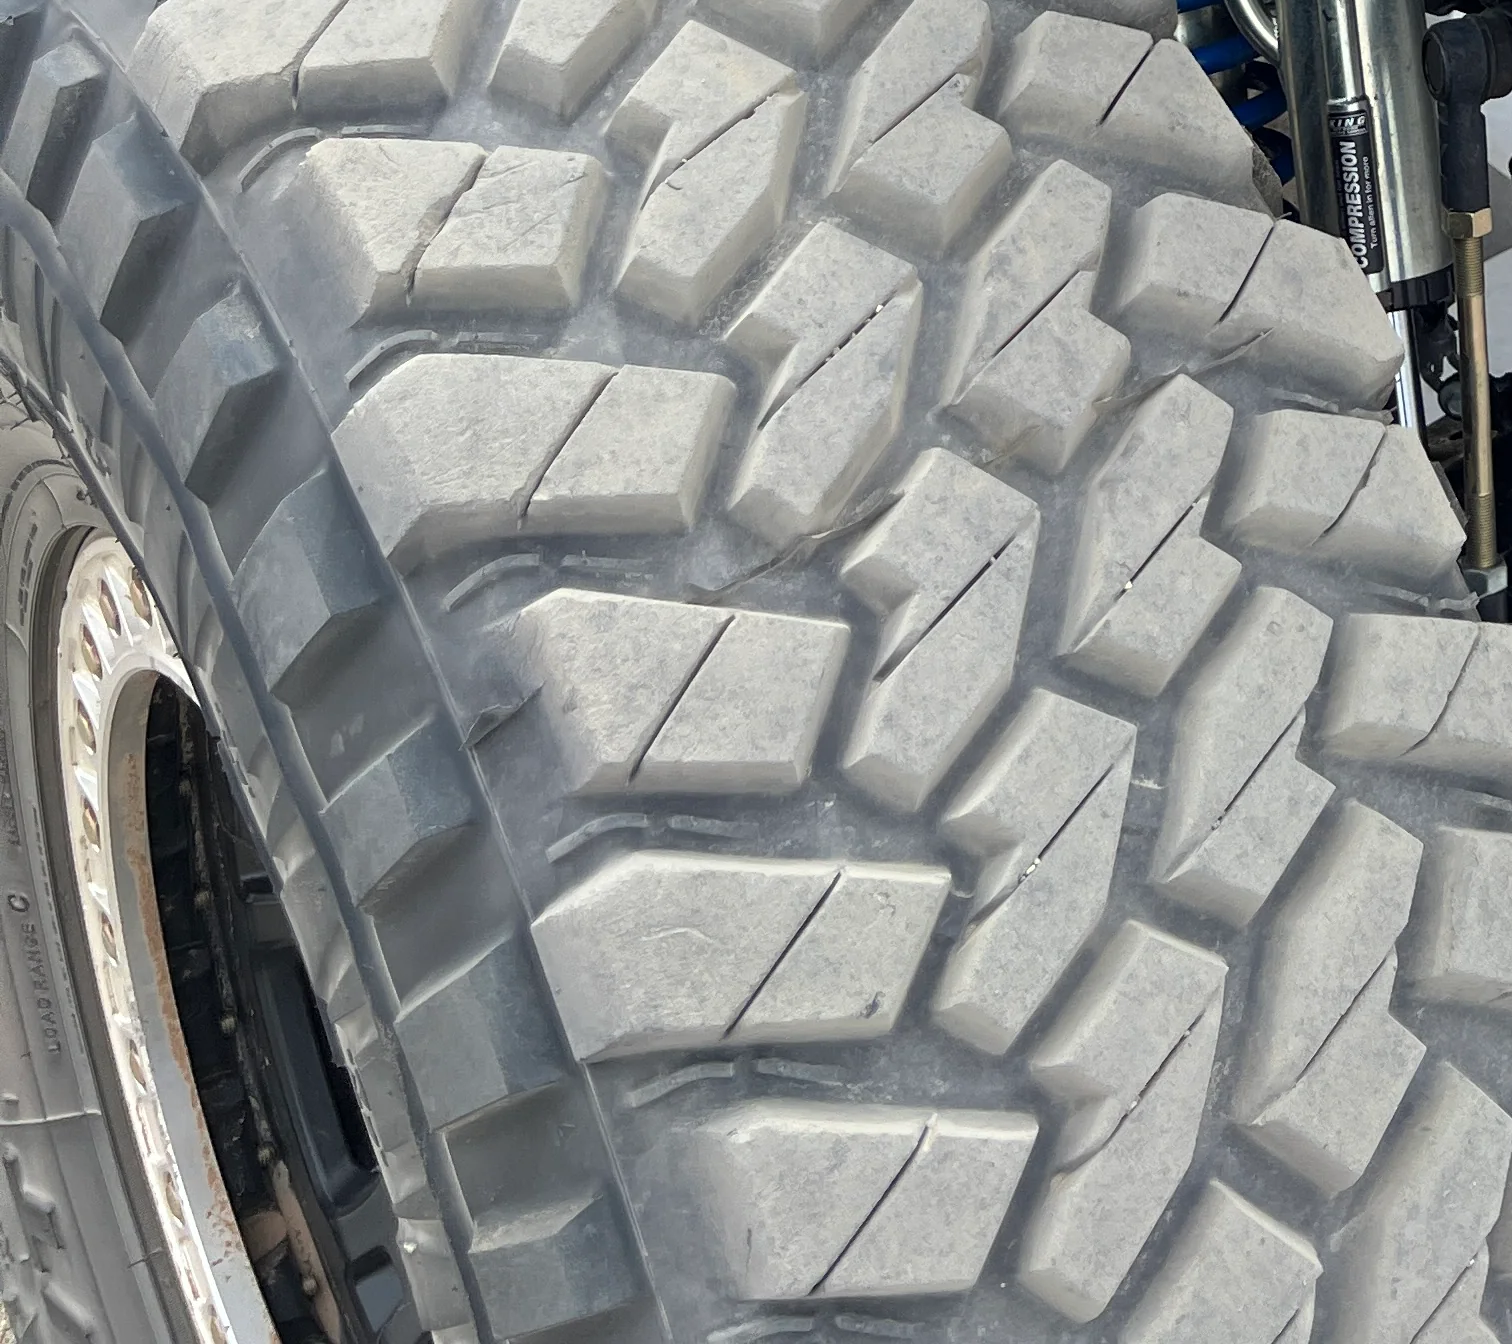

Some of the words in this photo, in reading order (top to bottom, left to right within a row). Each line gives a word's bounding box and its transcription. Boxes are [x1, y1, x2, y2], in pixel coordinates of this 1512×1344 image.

[1362, 156, 1370, 179] more
[1339, 140, 1369, 269] COMPRESSION
[1369, 228, 1379, 250] Turn
[20, 921, 50, 991] RANGE
[36, 997, 62, 1054] LOAD
